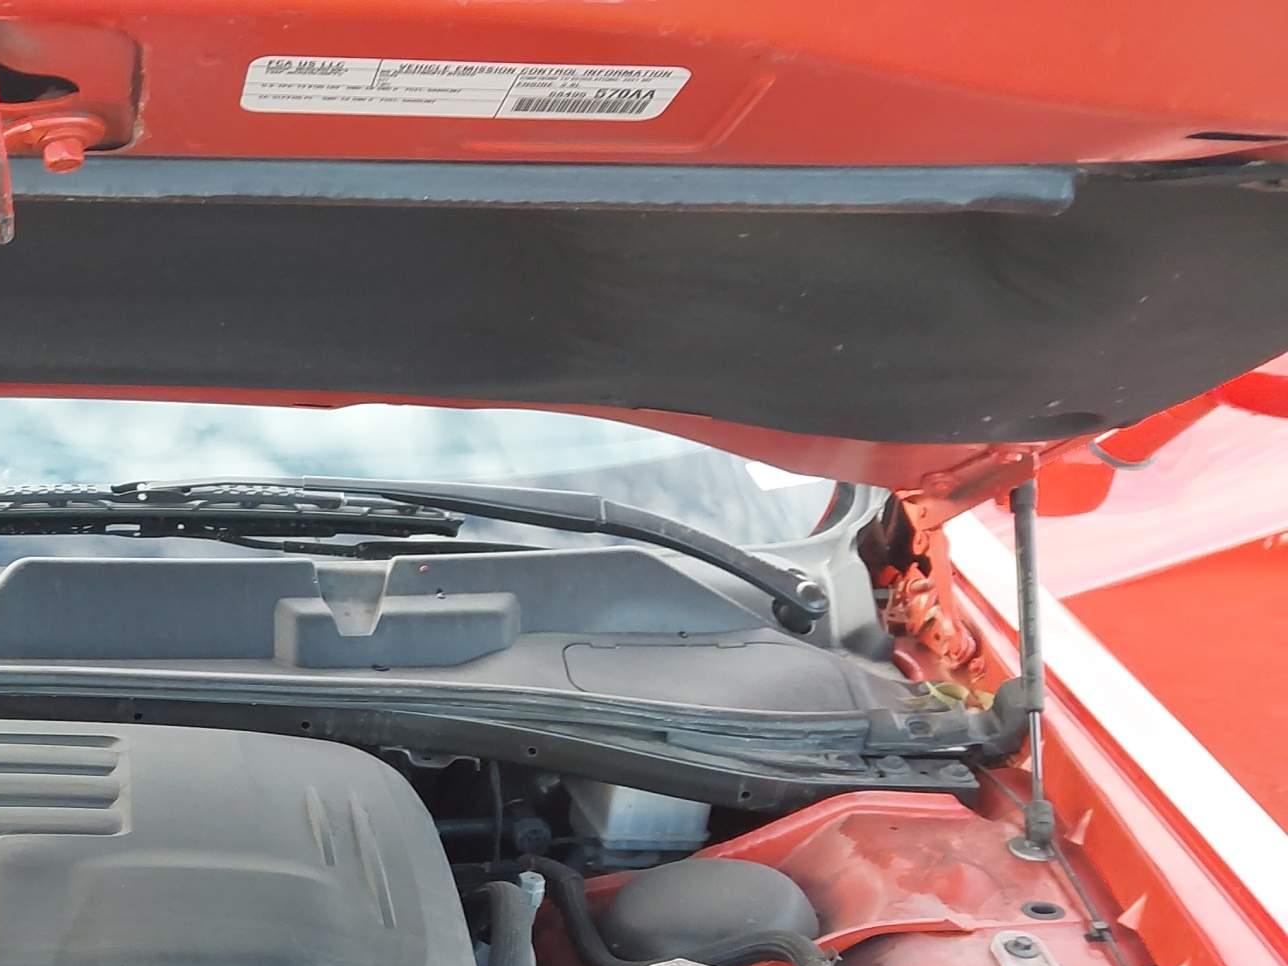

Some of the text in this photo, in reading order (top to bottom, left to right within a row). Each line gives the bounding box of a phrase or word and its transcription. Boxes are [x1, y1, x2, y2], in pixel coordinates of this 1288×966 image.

[399, 63, 673, 78] VEHICLE EMISSION CONTROL INFORMATION
